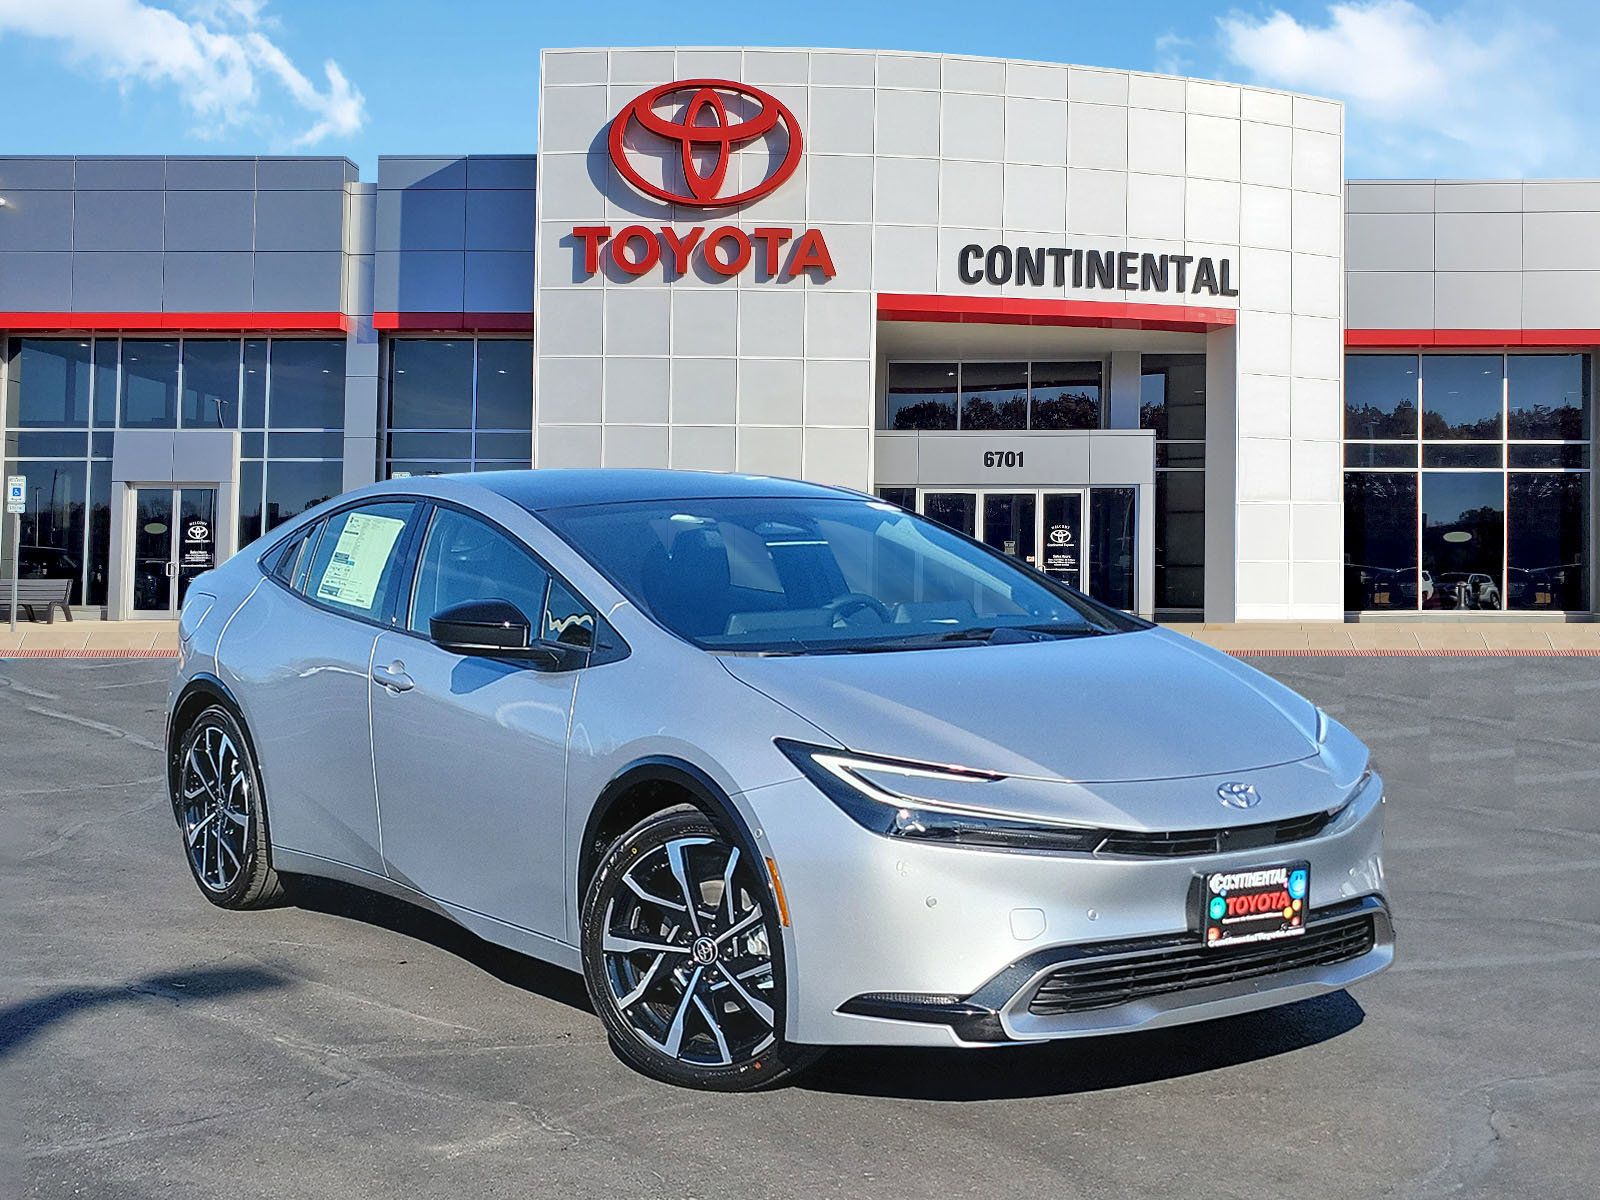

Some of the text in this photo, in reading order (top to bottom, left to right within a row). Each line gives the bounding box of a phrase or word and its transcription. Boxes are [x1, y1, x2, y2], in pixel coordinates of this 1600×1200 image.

[573, 225, 836, 278] TOYOTA
[958, 244, 1239, 297] CONTINENTAL
[983, 451, 1023, 468] 6701
[1209, 867, 1288, 894] CONTINENTAL
[1226, 890, 1290, 915] TOYOTA
